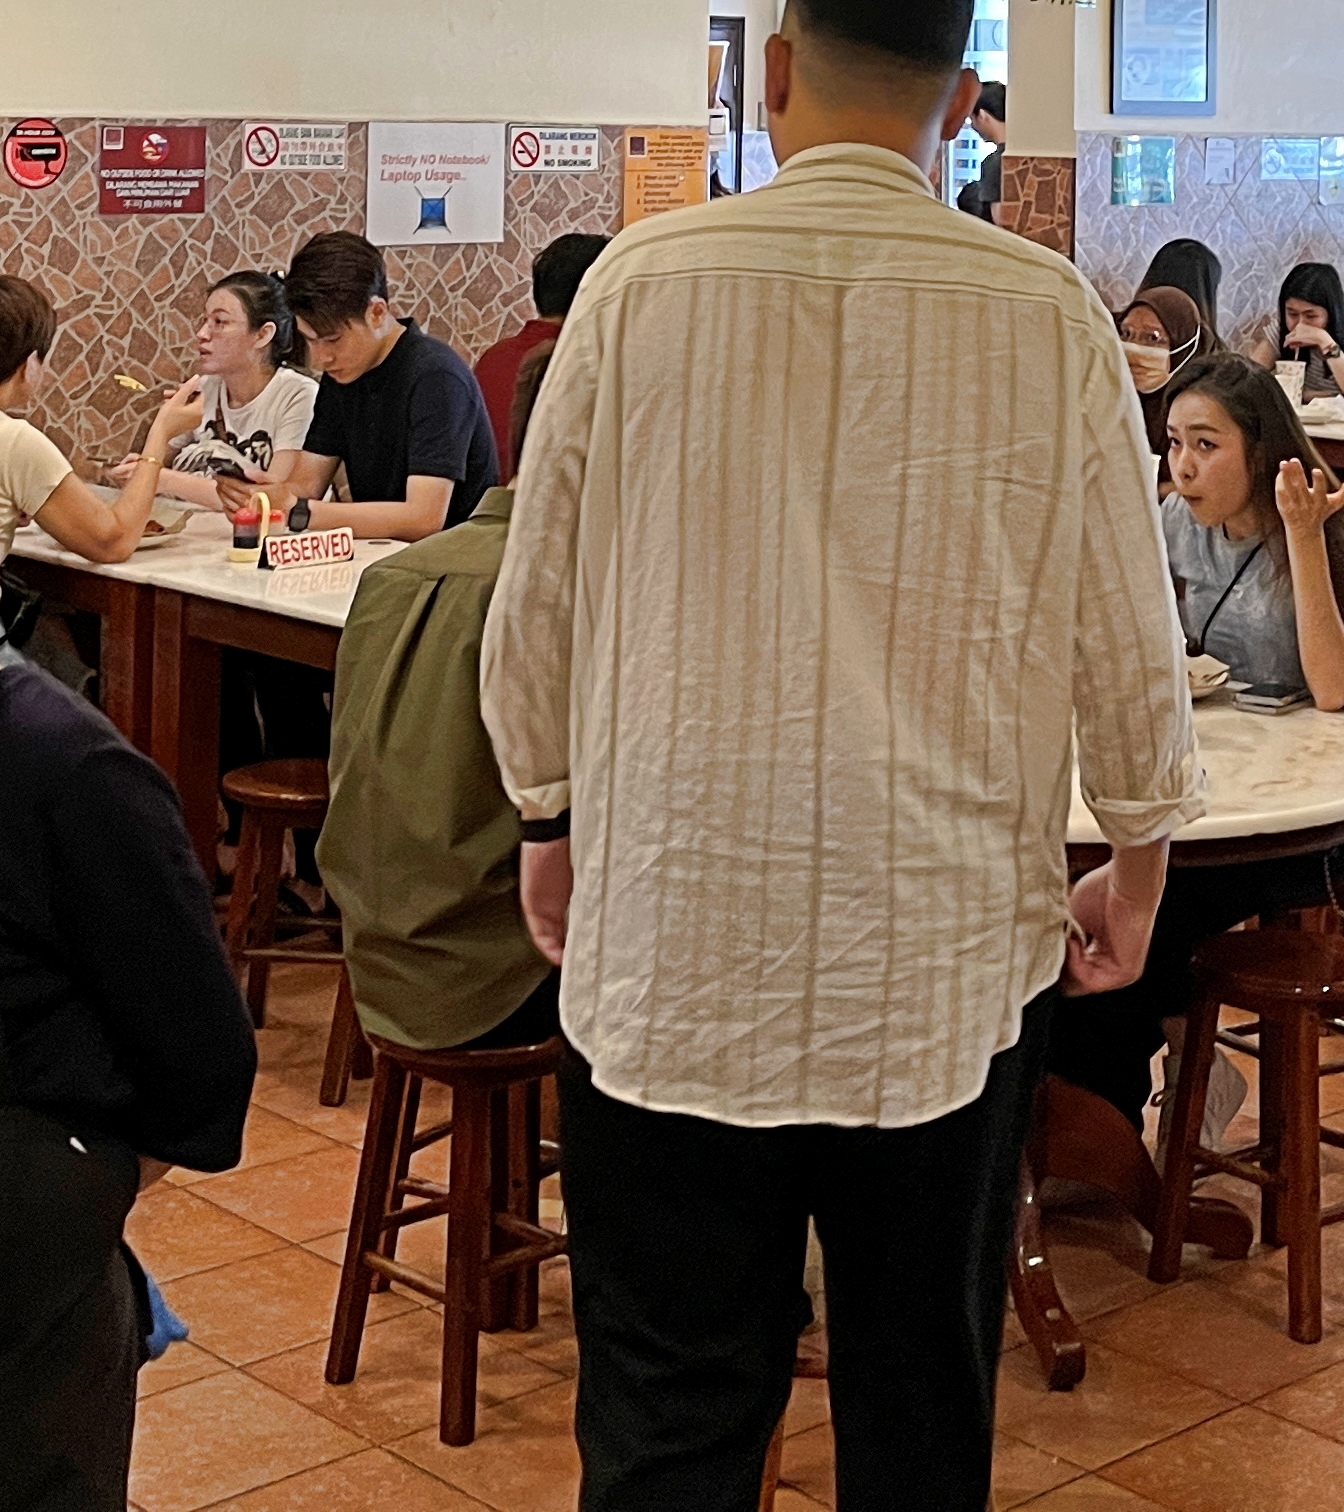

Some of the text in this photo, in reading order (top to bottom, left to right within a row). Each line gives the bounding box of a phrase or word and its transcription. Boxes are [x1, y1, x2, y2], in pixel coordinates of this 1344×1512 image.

[381, 154, 418, 167] Strictly
[420, 154, 436, 165] NO
[544, 159, 592, 167] NO SMOKING
[380, 169, 422, 184] Laptop
[269, 532, 351, 565] RESERVED
